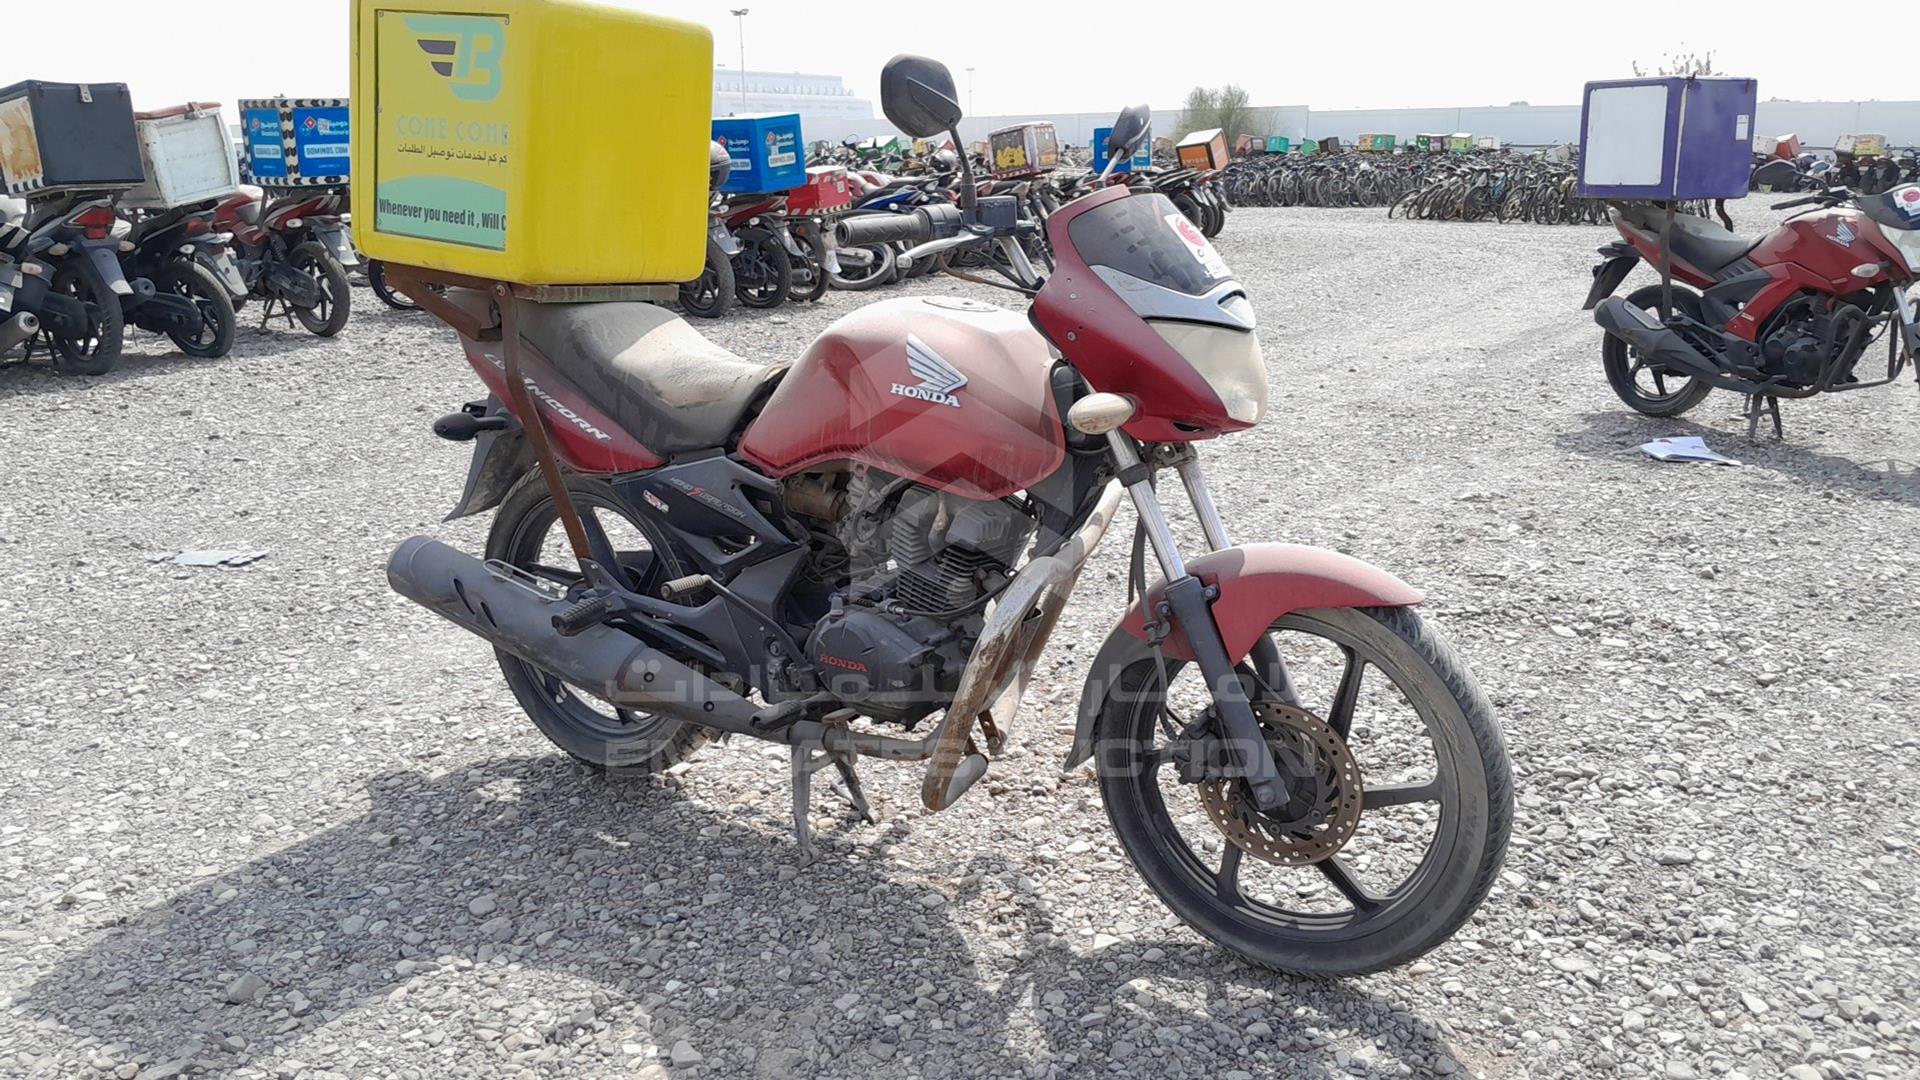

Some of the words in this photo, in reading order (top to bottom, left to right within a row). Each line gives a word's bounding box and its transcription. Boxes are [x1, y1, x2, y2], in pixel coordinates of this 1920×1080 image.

[378, 198, 422, 219] Whenever
[424, 207, 441, 223] you
[443, 210, 466, 225] need
[482, 212, 500, 230] Will
[889, 382, 961, 408] HONDA
[820, 655, 870, 673] HONDA
